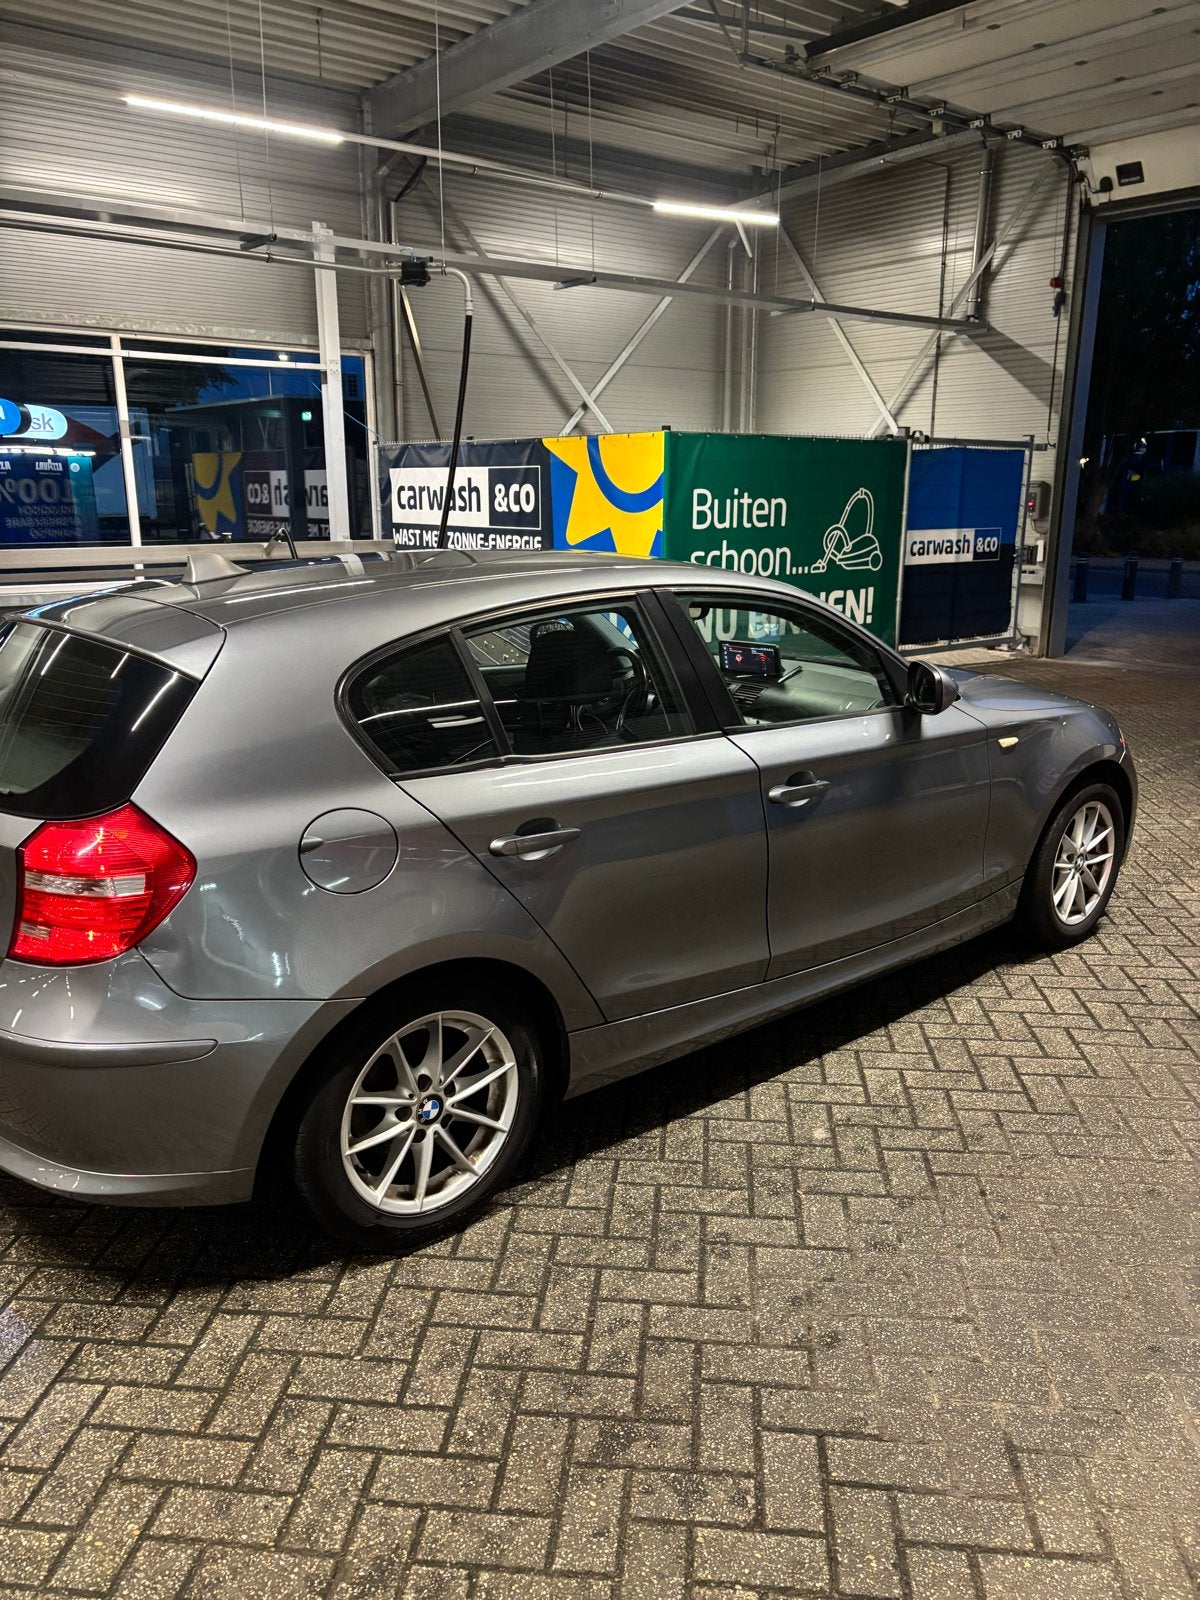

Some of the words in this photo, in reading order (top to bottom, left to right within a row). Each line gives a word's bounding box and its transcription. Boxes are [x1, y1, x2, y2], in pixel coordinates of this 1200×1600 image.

[397, 477, 481, 512] carwash
[692, 488, 787, 530] Buiten
[393, 528, 420, 546] WAST
[423, 530, 440, 547] ME
[447, 531, 542, 550] ZONNE-ENERGIE
[910, 534, 970, 557] carwash
